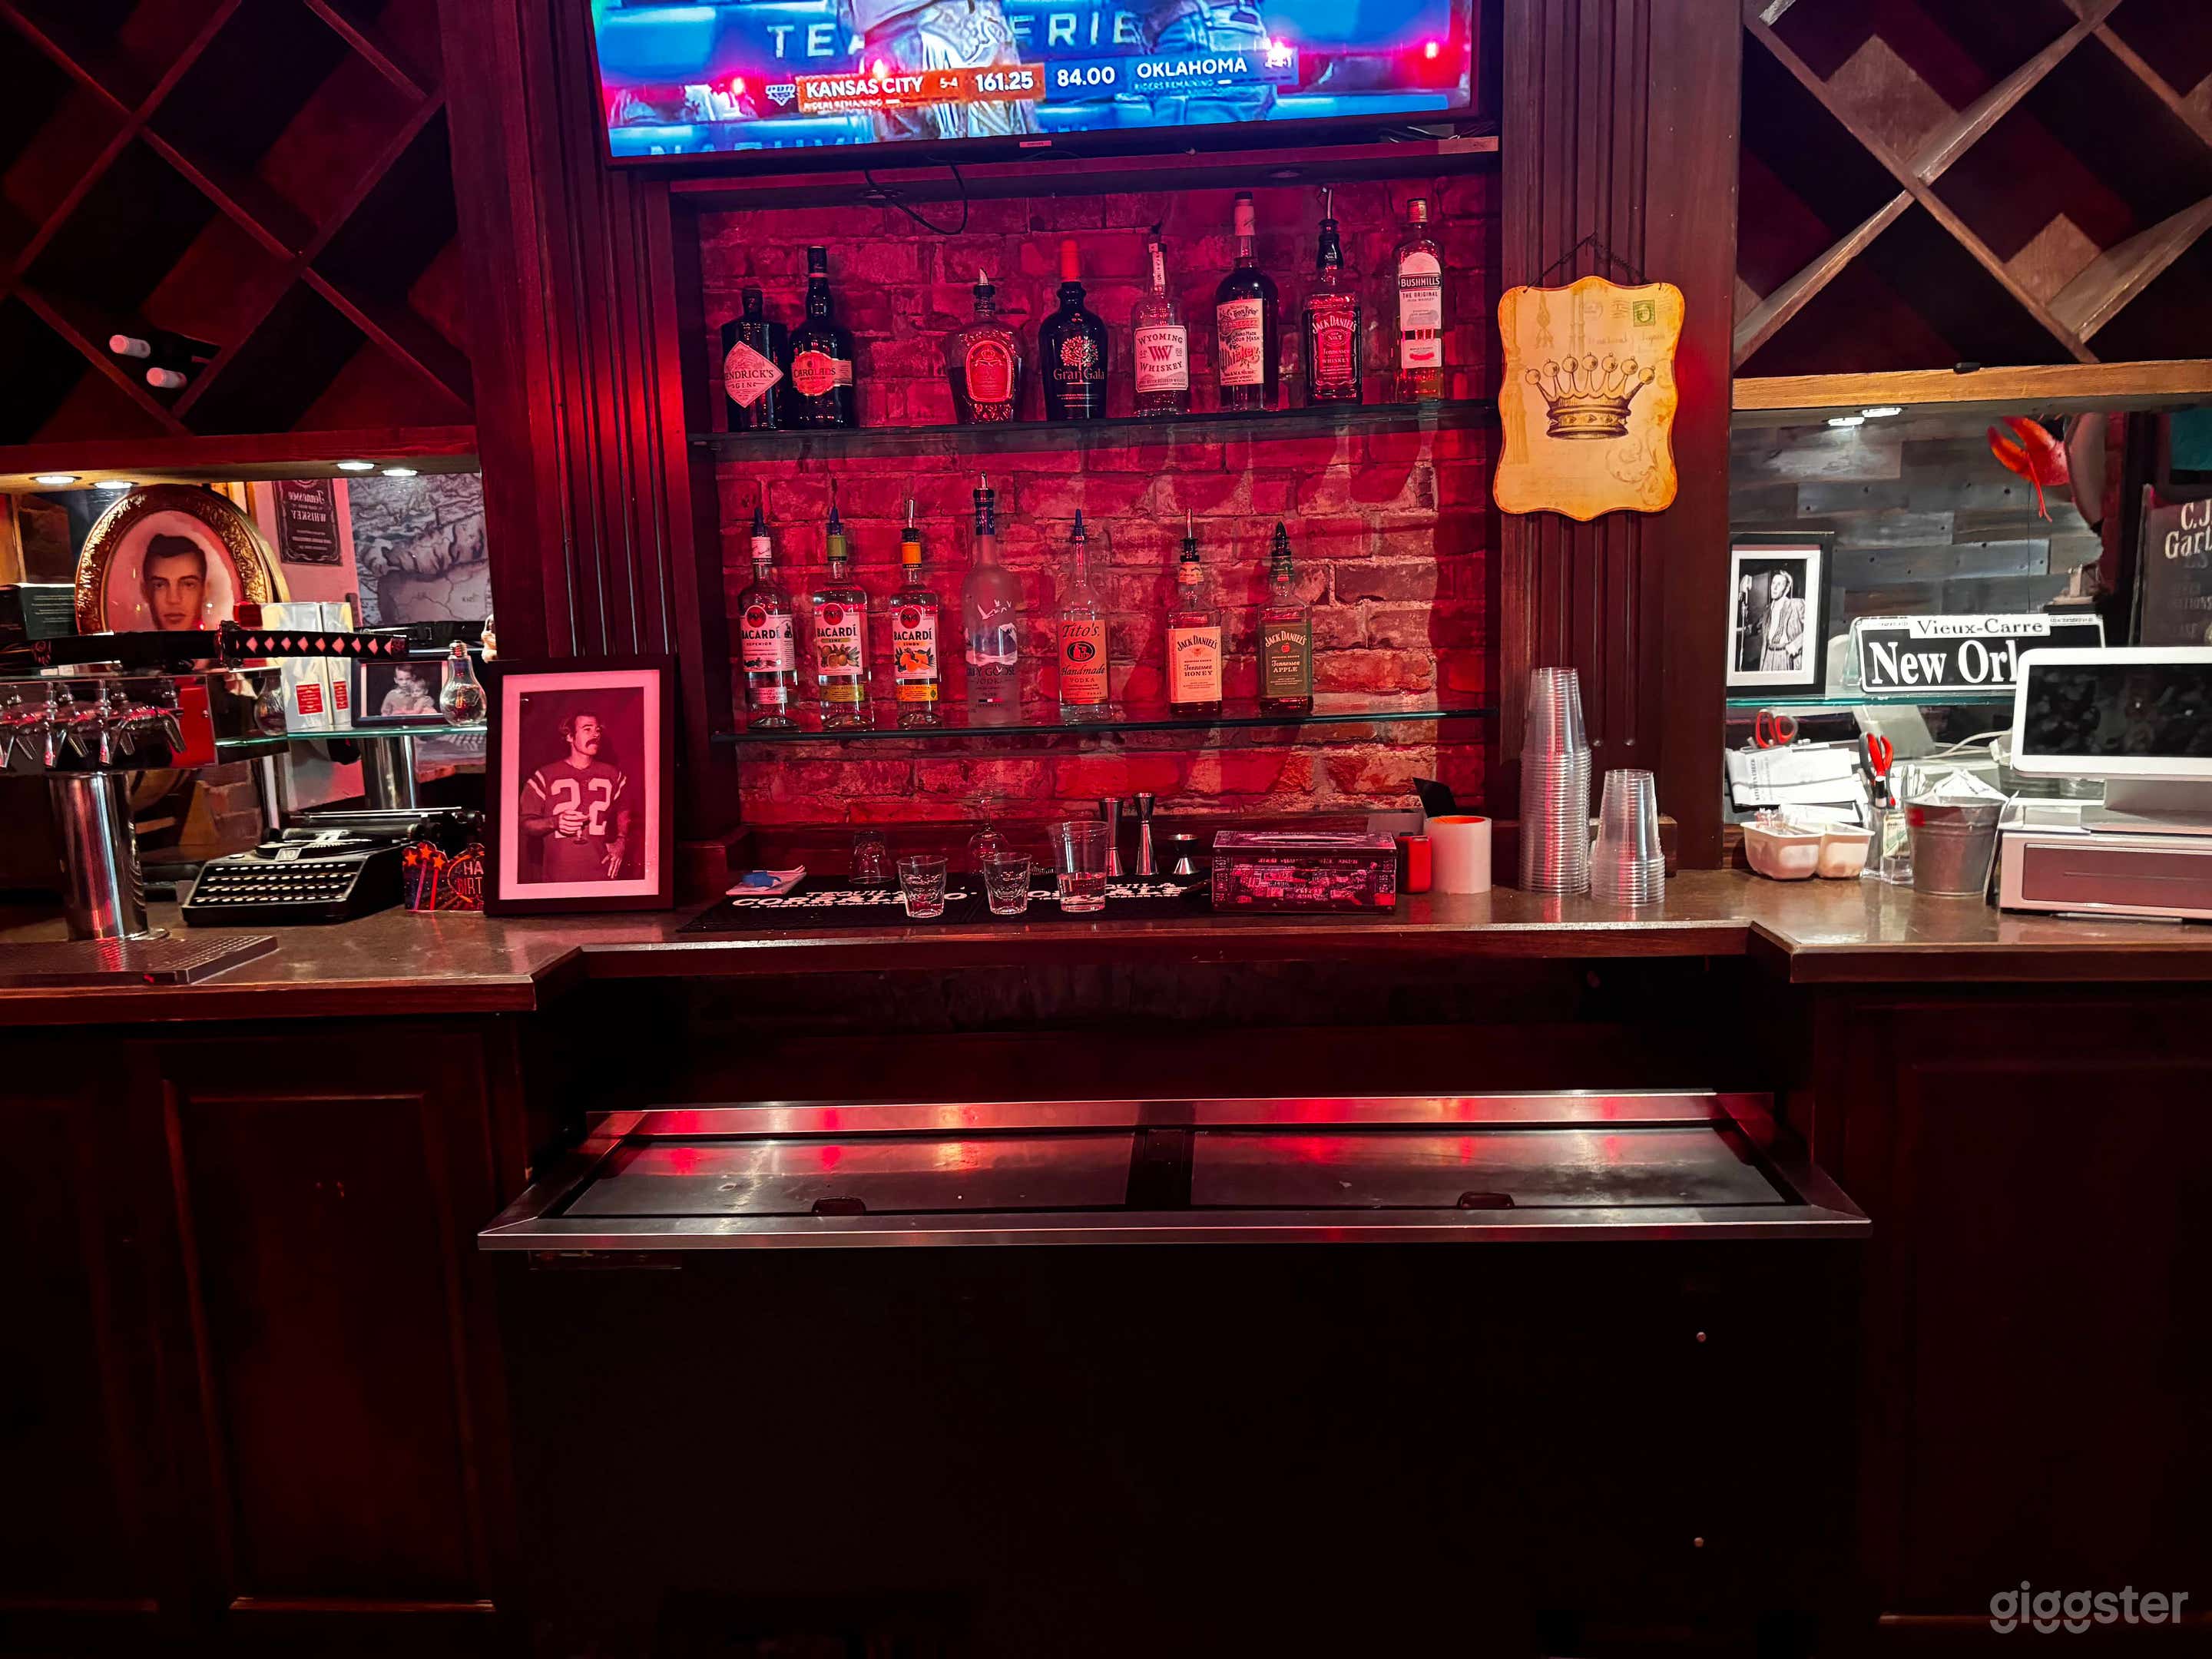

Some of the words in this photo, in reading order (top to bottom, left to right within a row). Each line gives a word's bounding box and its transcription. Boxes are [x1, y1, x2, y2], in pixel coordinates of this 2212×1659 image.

[1137, 57, 1247, 78] OKLAHOMA
[975, 71, 1034, 92] 161.25
[1058, 66, 1115, 87] 84.00
[806, 78, 879, 98] KANSAS
[882, 76, 923, 94] CITY
[1313, 319, 1330, 334] JACK
[1330, 315, 1357, 332] DANIEL'S
[1138, 333, 1183, 346] WYOMING
[725, 369, 774, 381] ENDRICK'S
[1053, 368, 1082, 381] Gran
[1084, 368, 1104, 381] Gala
[1140, 361, 1183, 373] WHISKEY
[893, 628, 932, 641] BACARDÍ
[1062, 622, 1099, 638] Tito's
[1917, 618, 2044, 635] Vieux-Carre
[1177, 637, 1193, 651] JACK
[1193, 634, 1217, 650] DANIEL'S
[1265, 634, 1281, 647] JACK
[1280, 631, 1306, 646] DANIEL'S
[1061, 664, 1105, 676] Handmade
[1869, 641, 1948, 686] New
[1958, 639, 2018, 684] Orl
